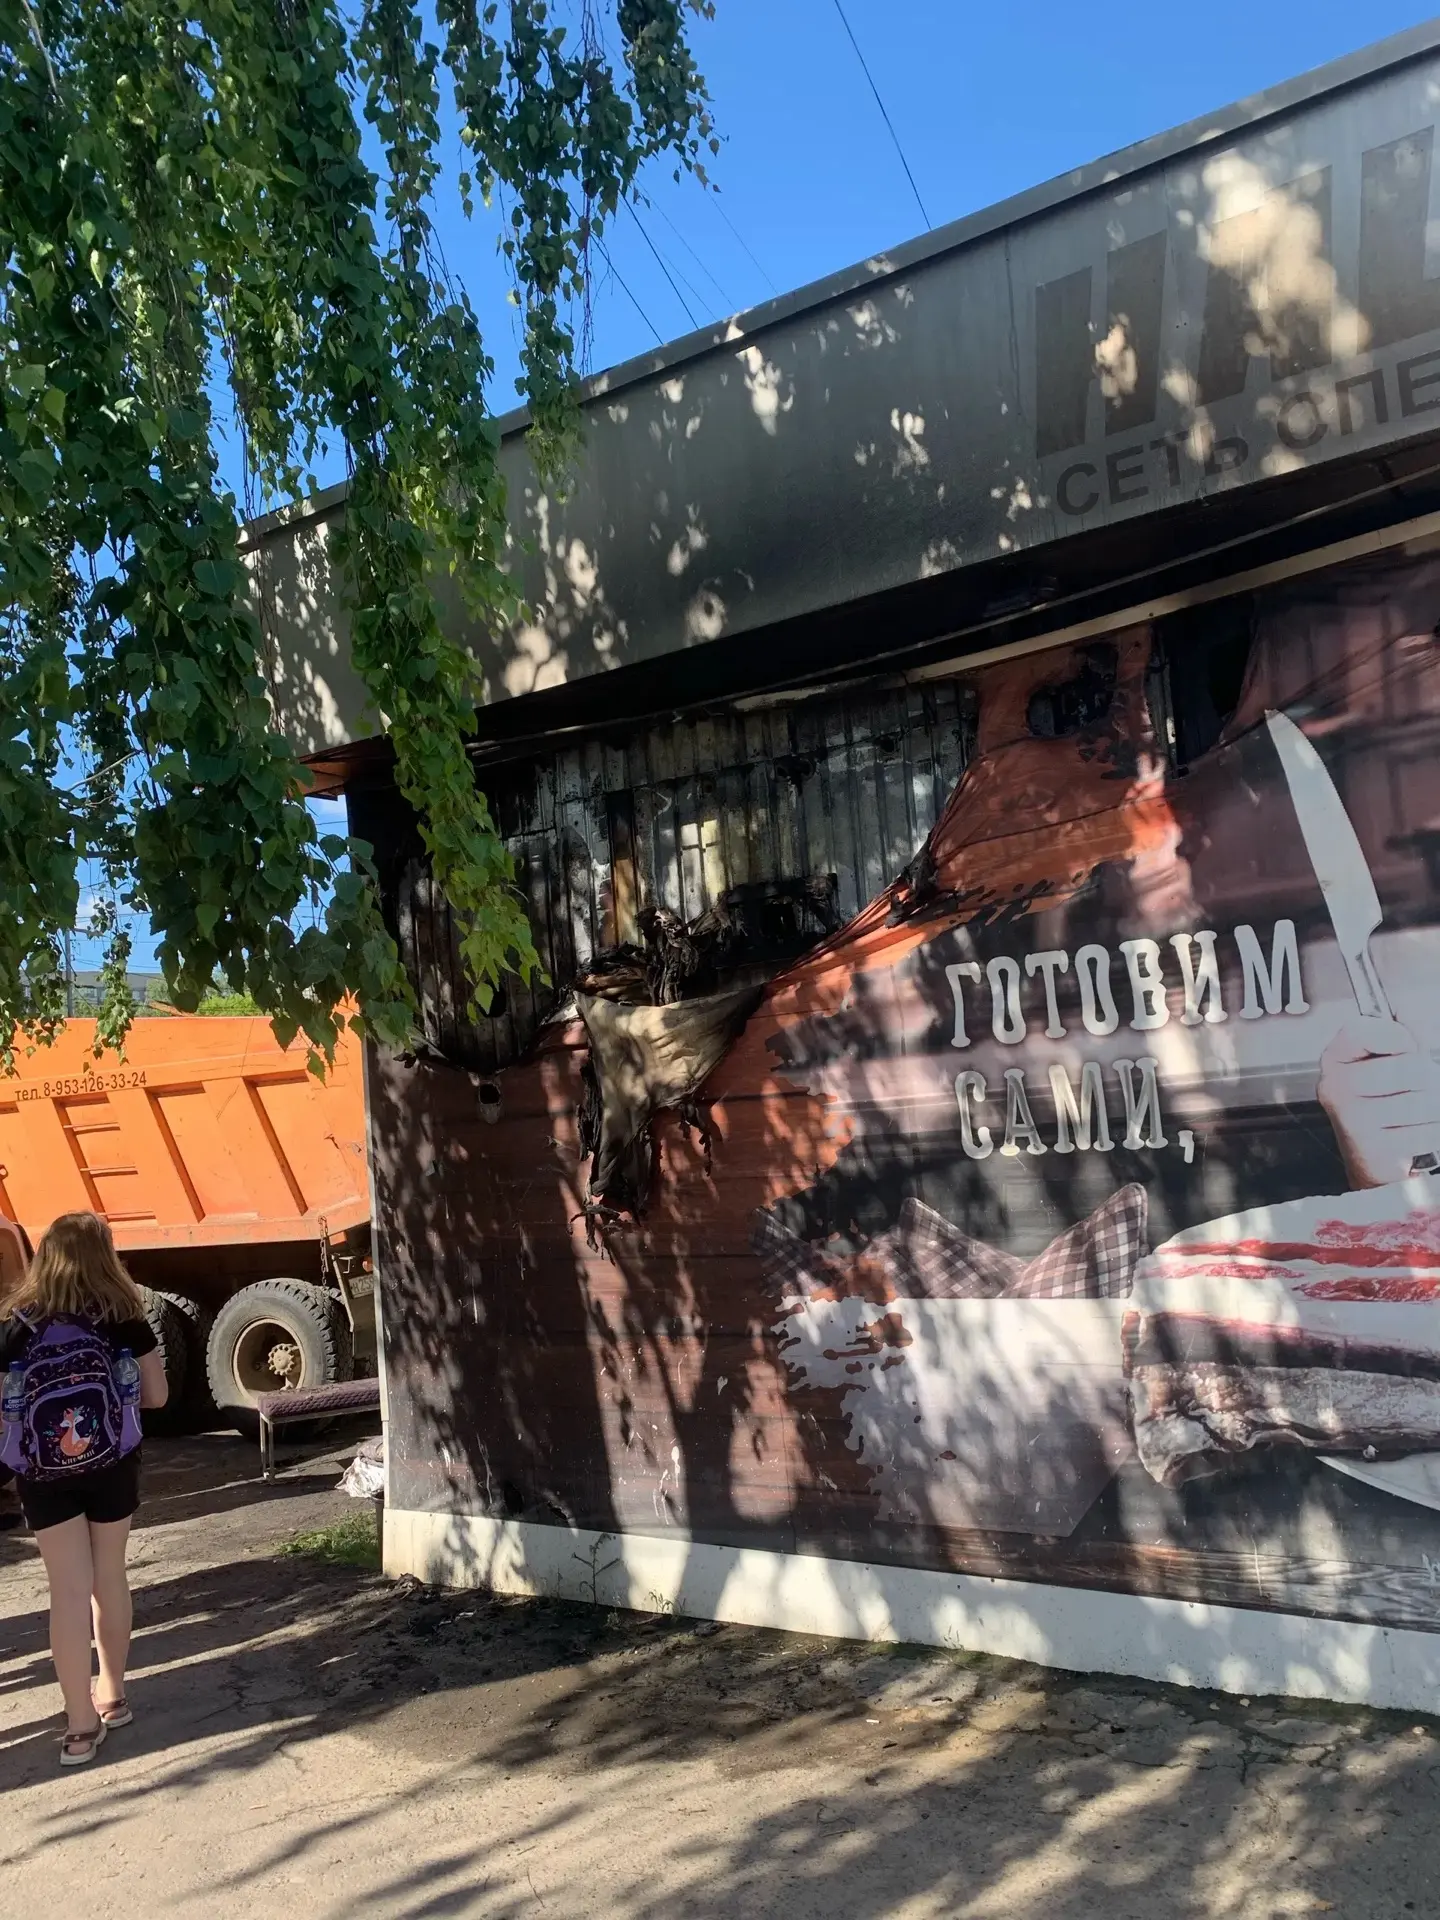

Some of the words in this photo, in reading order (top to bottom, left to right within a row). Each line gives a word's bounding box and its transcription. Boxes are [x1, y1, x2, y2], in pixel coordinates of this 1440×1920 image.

[1056, 421, 1249, 516] СЕТЬ
[945, 919, 1310, 1048] ГОТОВИМ
[15, 1089, 42, 1101] тел.
[44, 1071, 147, 1097] 8-953-126-33-24
[955, 1057, 1195, 1164] САМИ,
